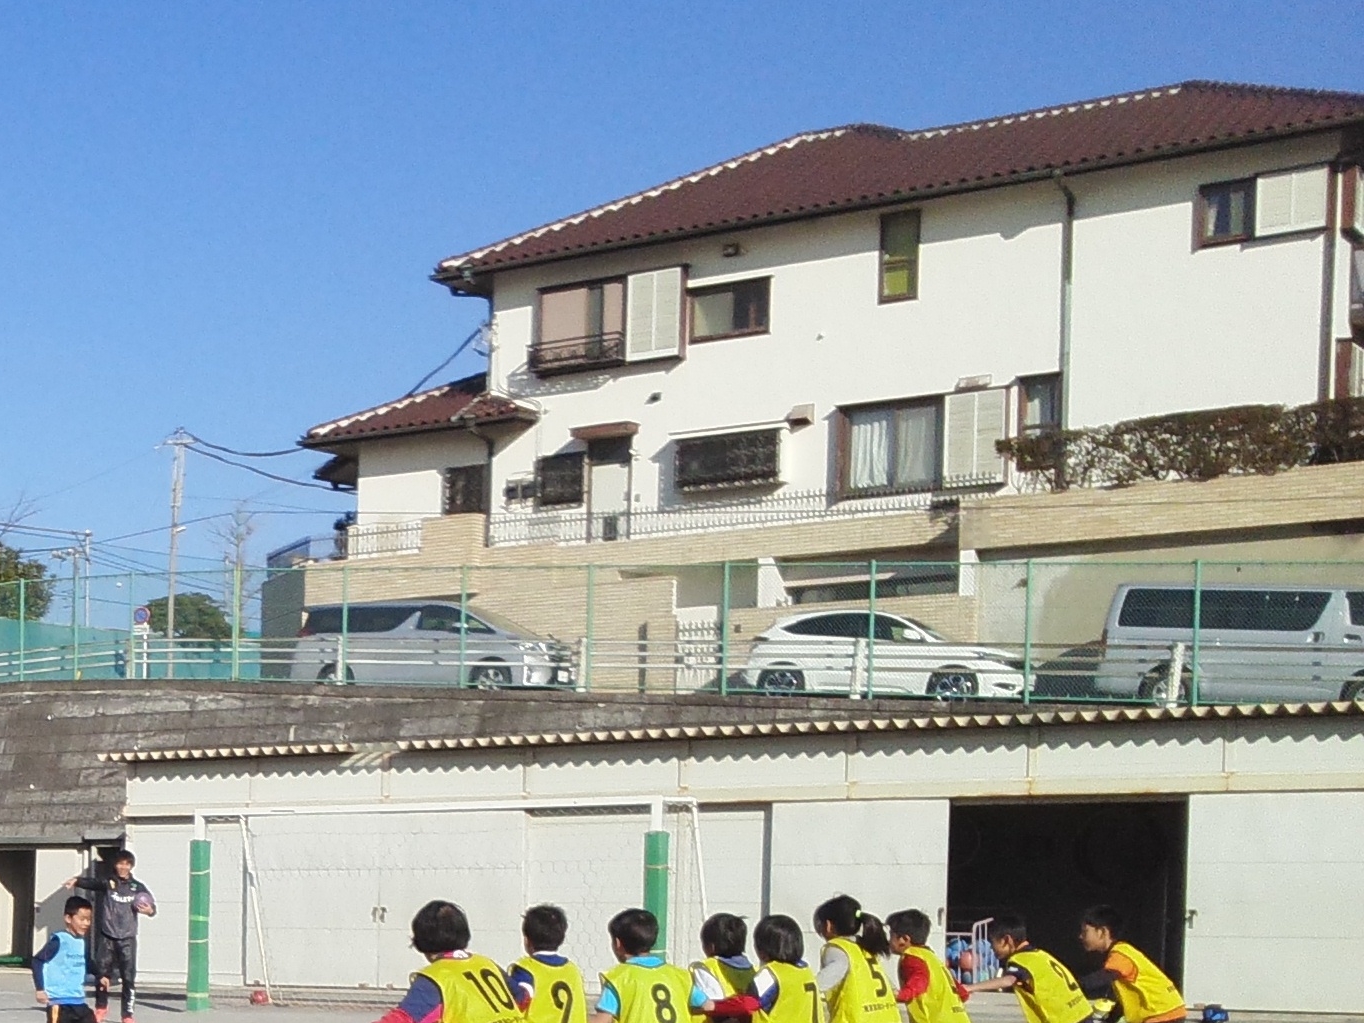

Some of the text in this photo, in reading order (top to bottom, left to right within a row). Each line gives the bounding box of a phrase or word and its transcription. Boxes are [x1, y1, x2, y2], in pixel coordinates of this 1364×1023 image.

[463, 969, 515, 1013] 10
[866, 957, 887, 997] 5
[1049, 960, 1079, 991] 2
